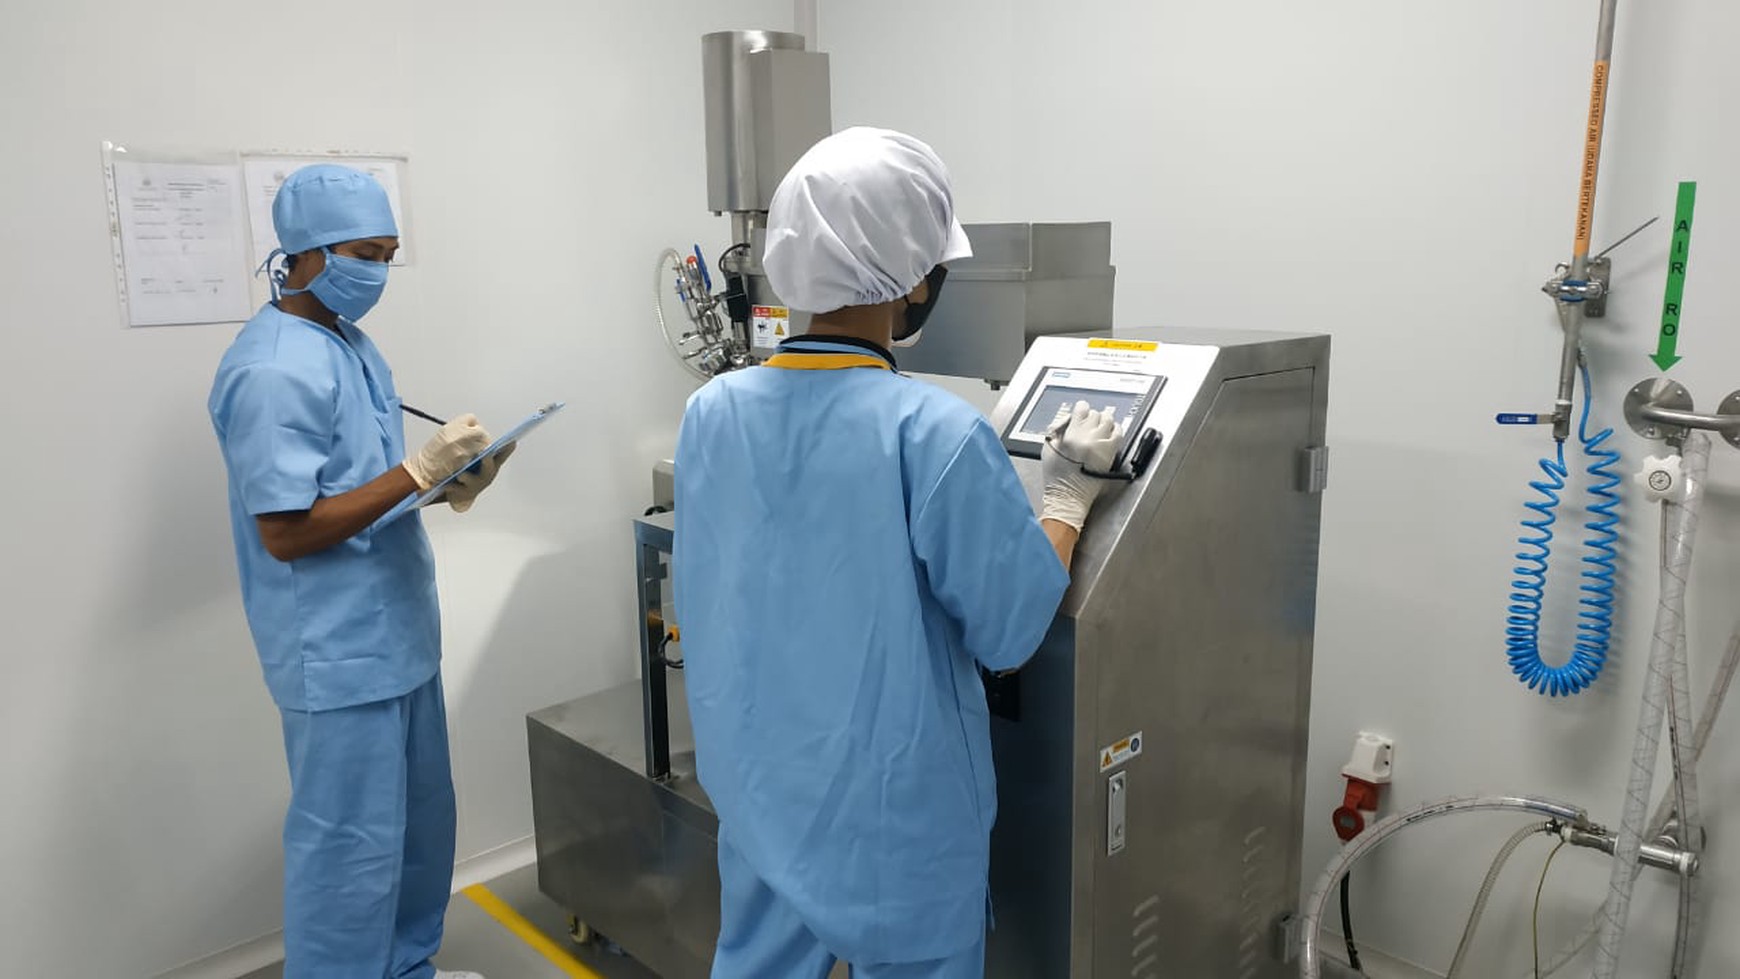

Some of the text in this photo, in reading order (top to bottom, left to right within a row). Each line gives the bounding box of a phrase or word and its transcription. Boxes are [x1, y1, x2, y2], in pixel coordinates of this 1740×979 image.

[1591, 65, 1603, 125] COMPRESSED
[1587, 127, 1598, 142] AIR
[1663, 219, 1688, 336] AIR RO
